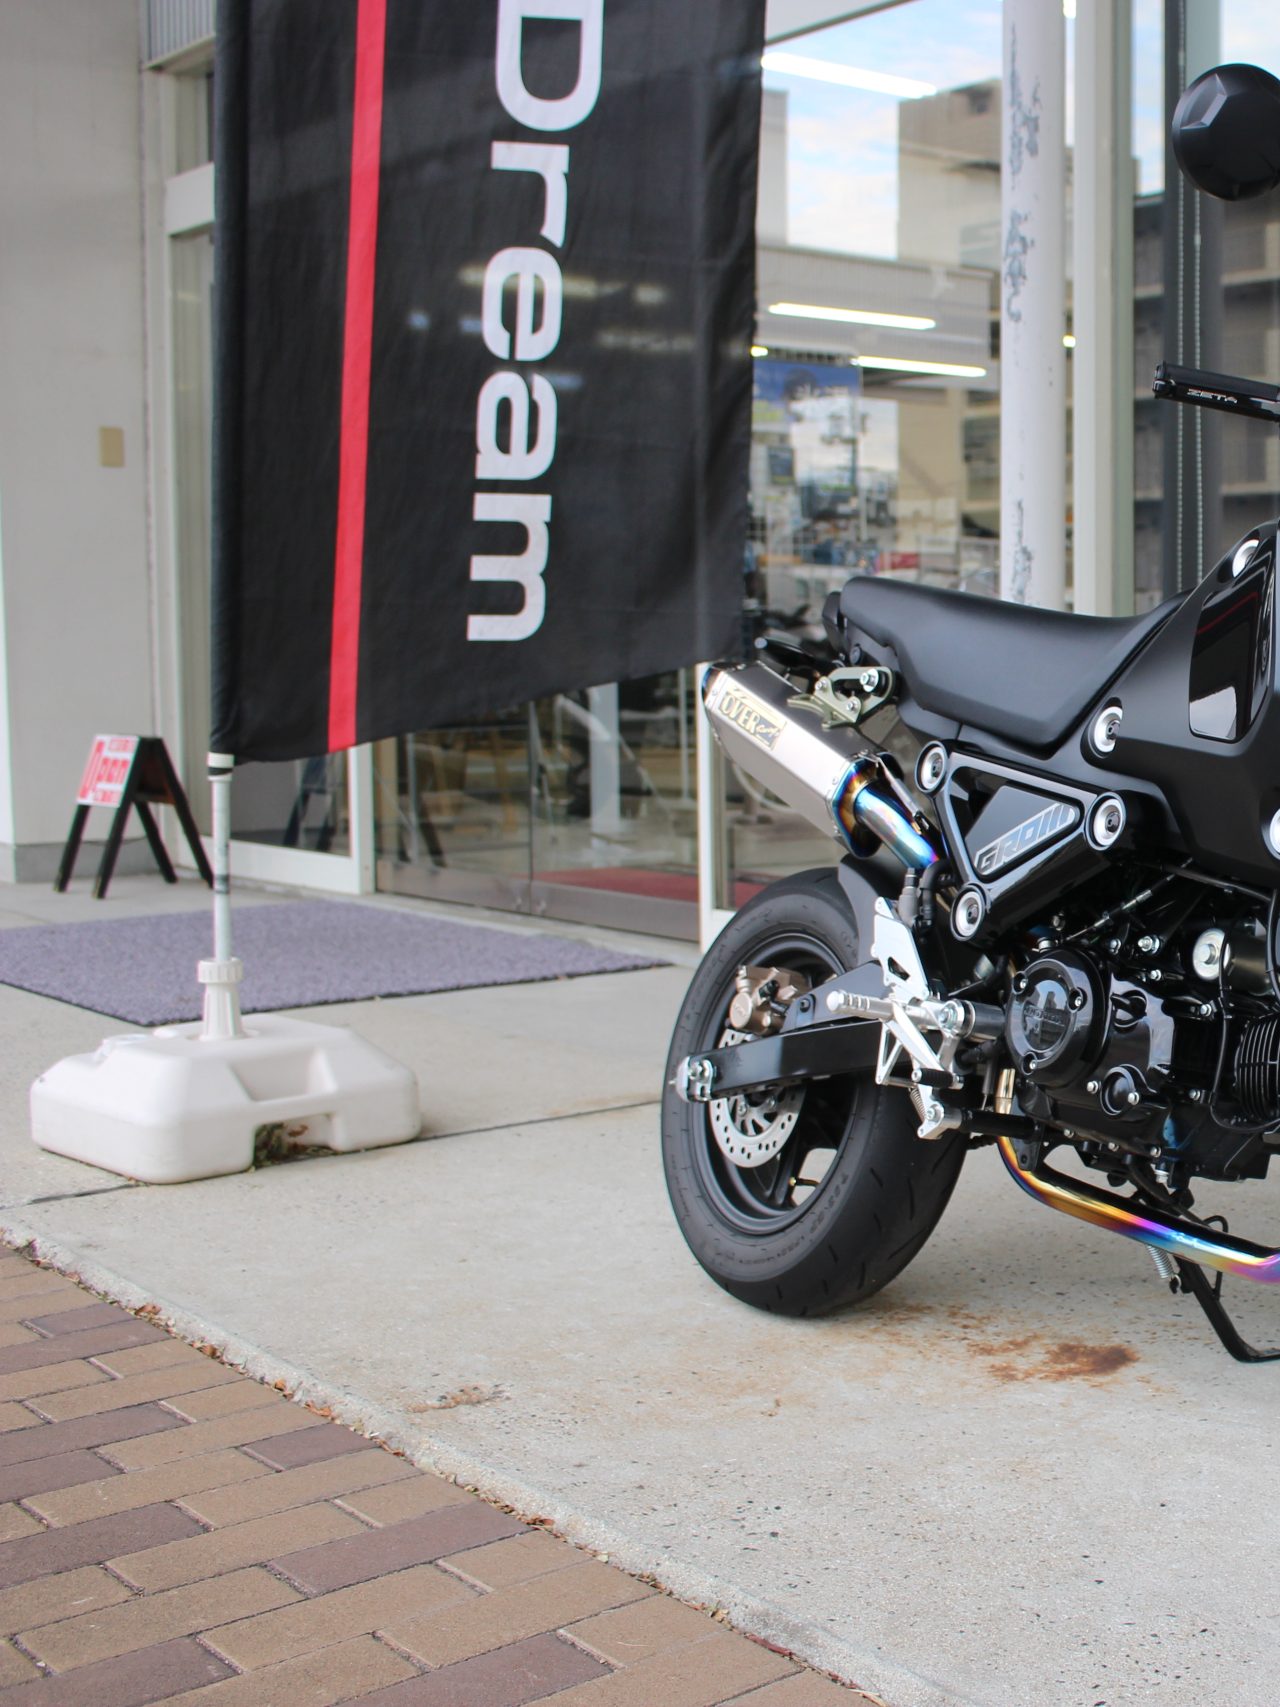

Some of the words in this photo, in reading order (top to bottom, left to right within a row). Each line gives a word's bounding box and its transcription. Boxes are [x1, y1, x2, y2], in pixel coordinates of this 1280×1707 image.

[466, 0, 605, 643] Dream
[1186, 388, 1238, 404] ZETA
[718, 692, 761, 735] OVER
